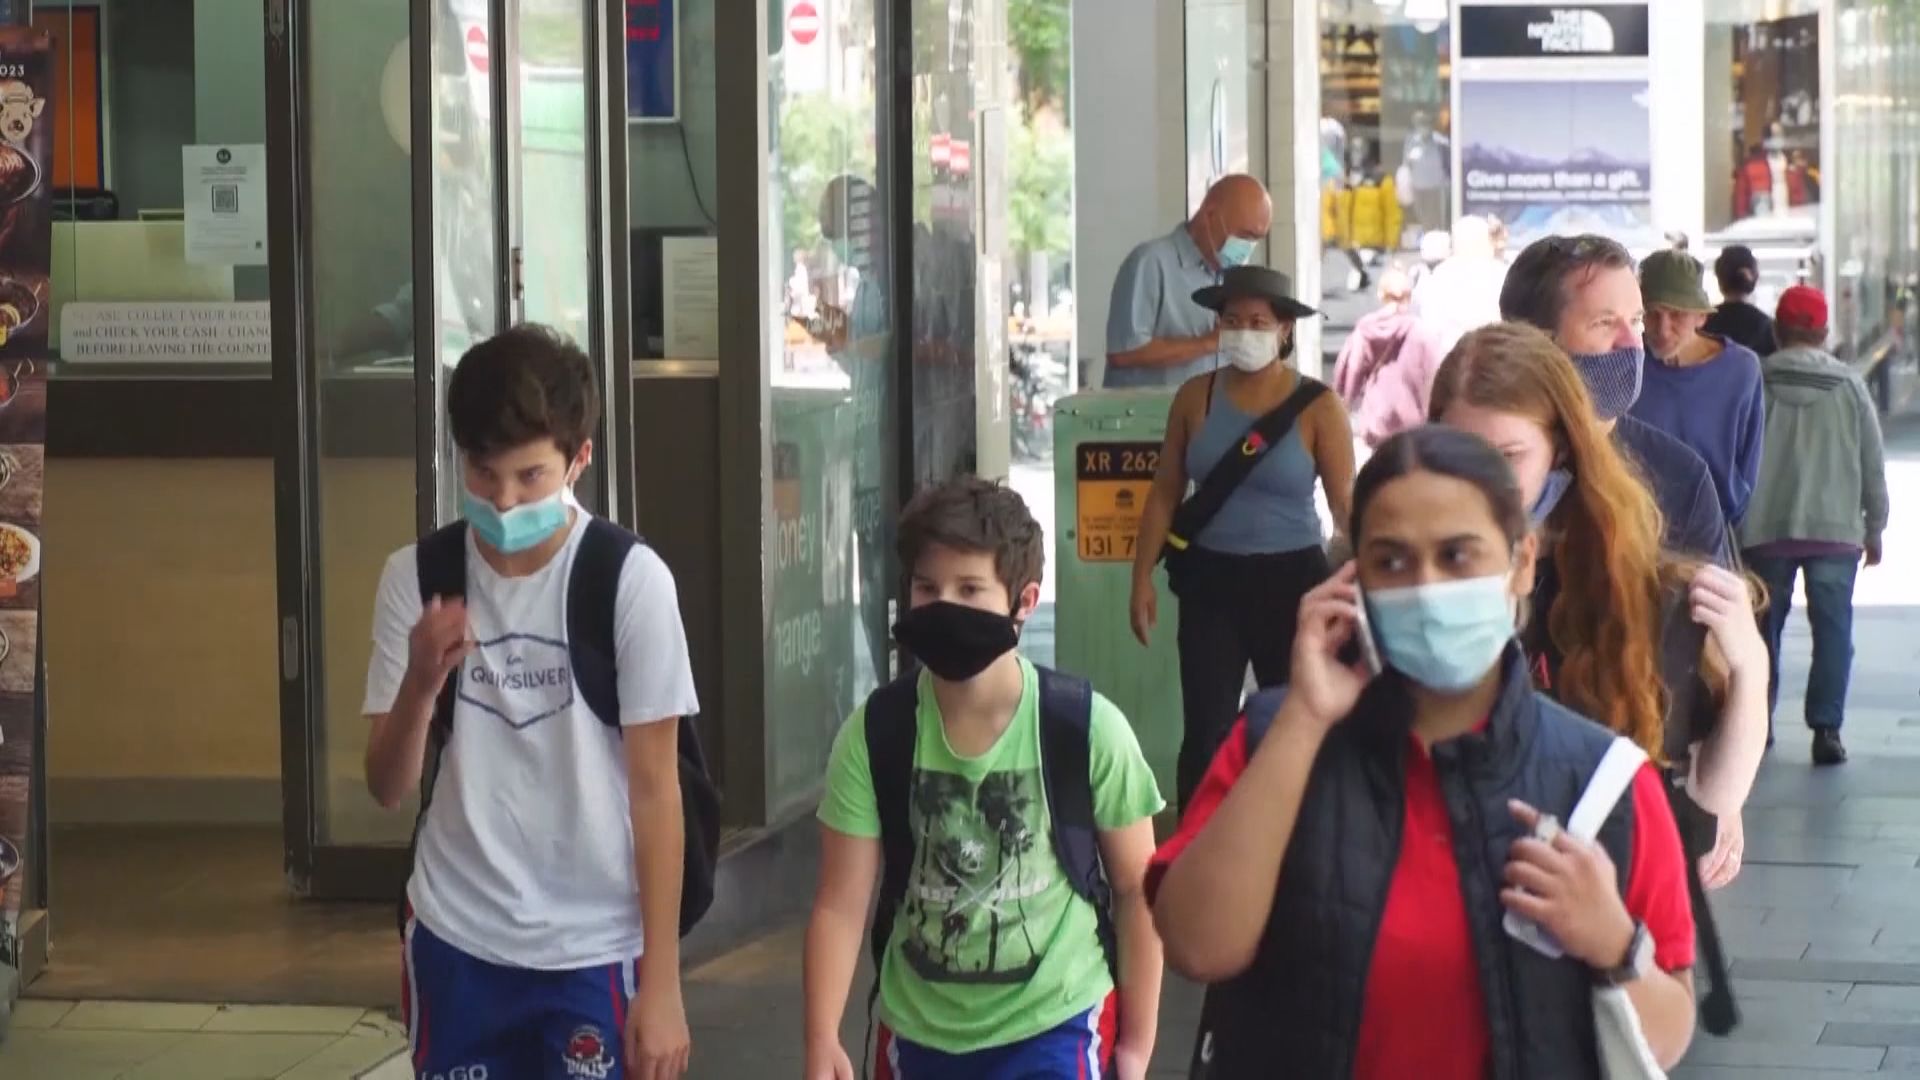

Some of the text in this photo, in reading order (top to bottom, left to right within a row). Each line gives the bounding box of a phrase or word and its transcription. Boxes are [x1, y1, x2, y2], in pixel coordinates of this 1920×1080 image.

[1467, 169, 1641, 191] Give more than a gift.
[127, 309, 185, 321] COLLECT
[189, 309, 225, 321] YOUR
[73, 326, 92, 338] and
[95, 325, 139, 338] CHECK
[142, 325, 179, 338] YOUR
[182, 325, 217, 338] CASH
[76, 342, 125, 355] BEFORE
[130, 342, 186, 355] LEAVING
[191, 342, 214, 355] THE
[1085, 450, 1112, 472] XR
[772, 508, 816, 575] oney
[1085, 535, 1112, 556] 131
[471, 665, 569, 689] QUIKSILVER
